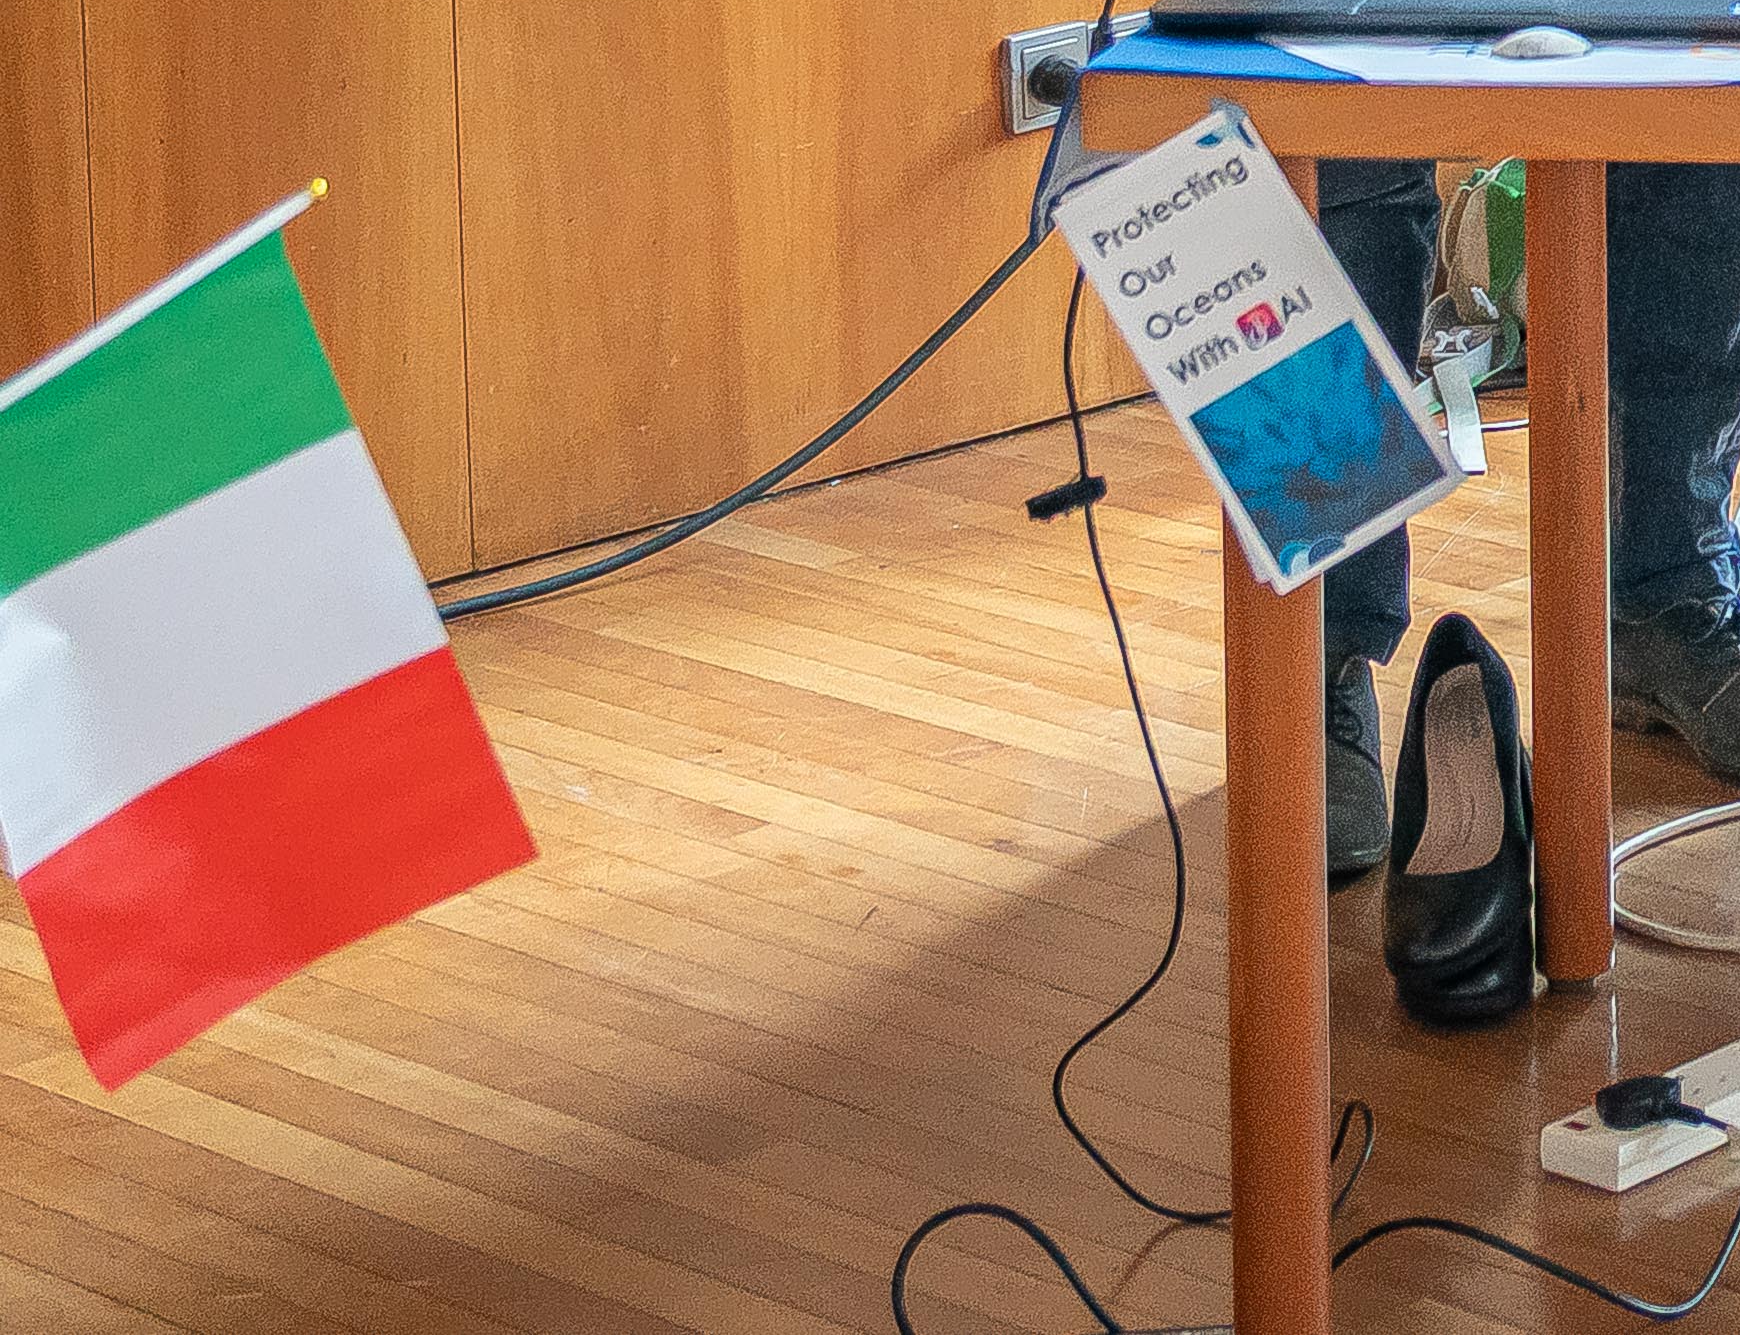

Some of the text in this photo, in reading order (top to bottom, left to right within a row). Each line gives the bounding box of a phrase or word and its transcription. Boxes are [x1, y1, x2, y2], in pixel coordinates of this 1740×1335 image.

[1092, 152, 1250, 258] Protecting
[1118, 252, 1176, 298] Our
[1144, 257, 1268, 340] Oceans
[1166, 285, 1313, 385] With AI
